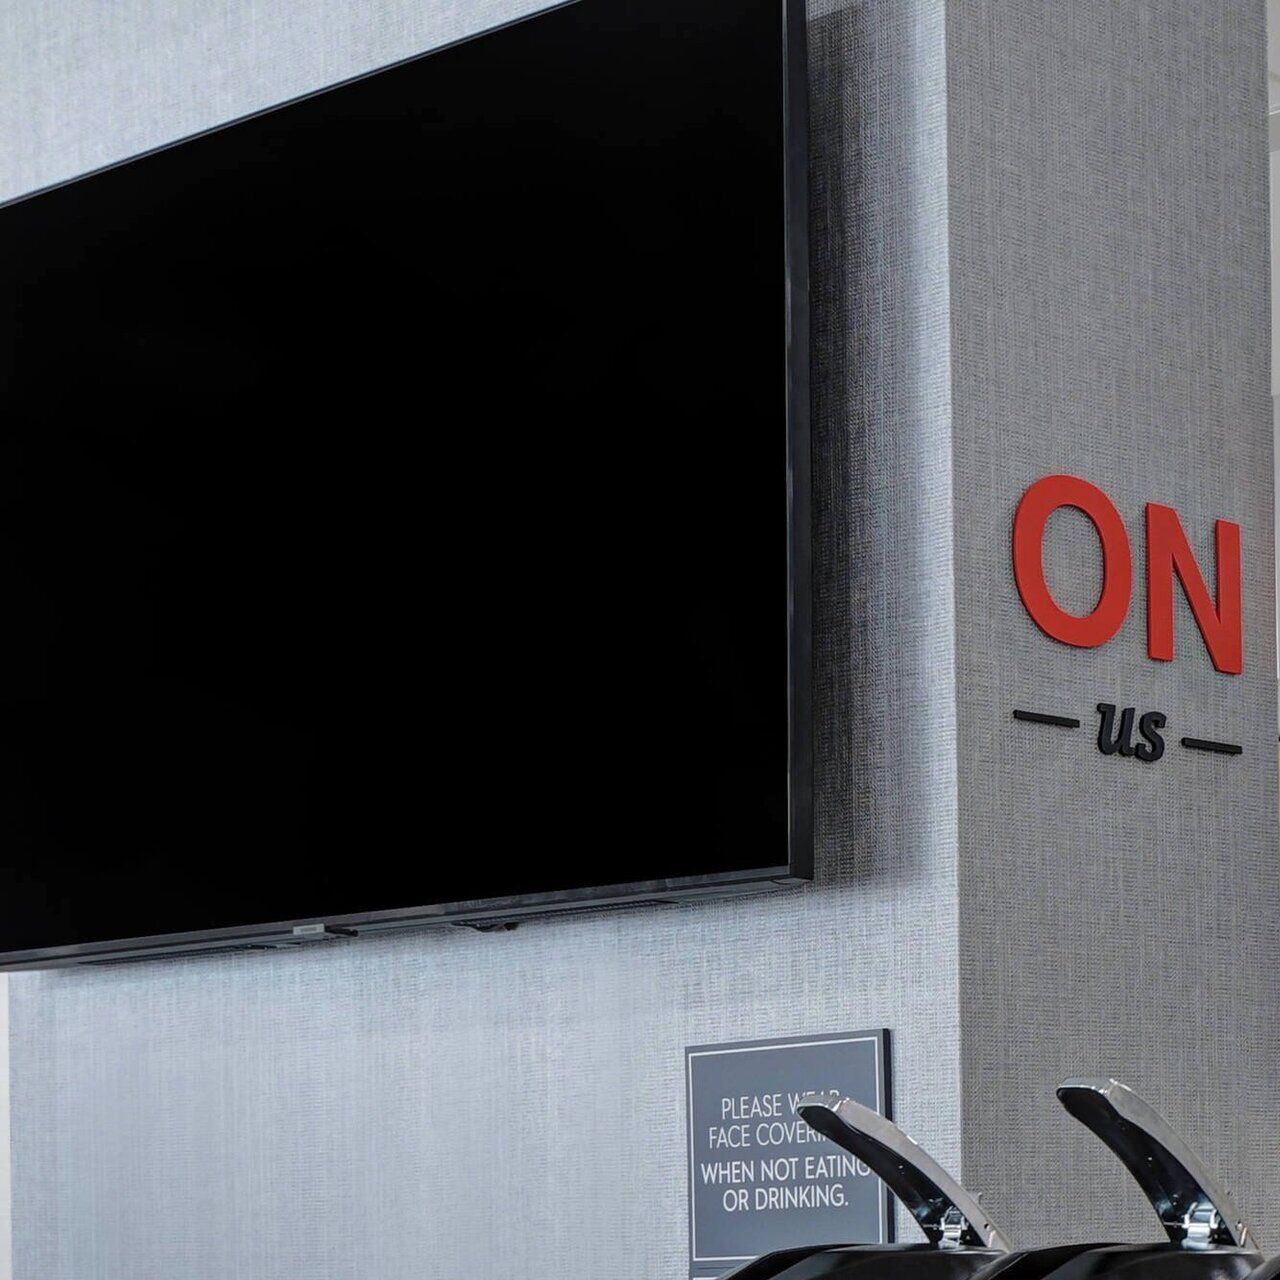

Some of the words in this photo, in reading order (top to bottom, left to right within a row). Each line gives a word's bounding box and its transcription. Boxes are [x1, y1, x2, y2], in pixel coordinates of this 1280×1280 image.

[1012, 474, 1242, 675] ON
[1097, 703, 1167, 762] us
[721, 1094, 782, 1120] PLEASE
[708, 1124, 751, 1150] FACE
[701, 1159, 755, 1185] WHEN
[761, 1157, 800, 1182] NOT
[805, 1154, 871, 1180] EATING
[723, 1189, 749, 1213] OR
[756, 1183, 849, 1211] DRINKING.
